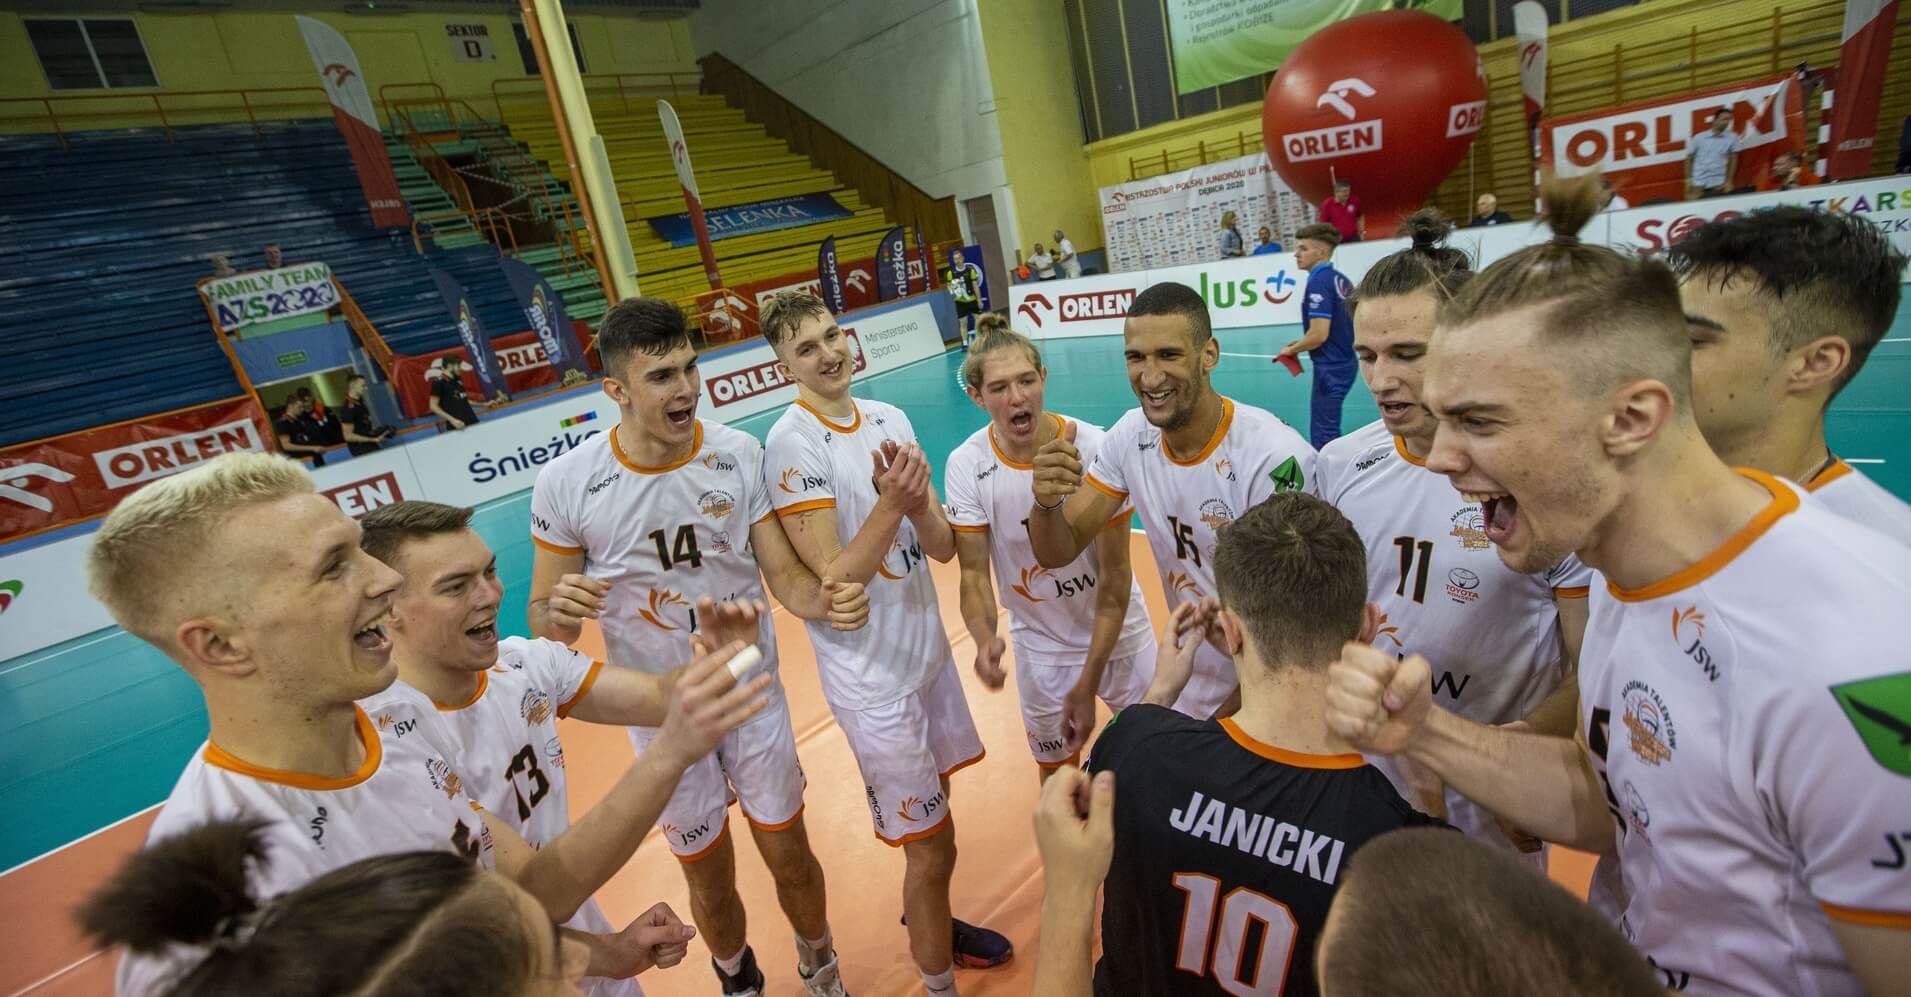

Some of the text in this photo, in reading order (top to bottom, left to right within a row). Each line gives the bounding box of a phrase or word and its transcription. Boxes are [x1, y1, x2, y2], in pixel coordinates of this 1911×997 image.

[463, 40, 482, 58] D
[1290, 125, 1374, 156] ORLEN
[827, 252, 843, 311] nieżka
[892, 240, 907, 297] nieżka
[1062, 293, 1132, 320] ORLEN
[1200, 272, 1259, 309] lus
[865, 321, 918, 344] Ministerstwo
[497, 346, 546, 372] ORLE
[871, 343, 900, 359] Sportu
[713, 362, 790, 401] ORLE
[109, 426, 253, 479] ORLEN
[715, 462, 735, 471] JSW
[1450, 506, 1478, 523] AKADEMIA
[648, 524, 702, 571] 14
[1167, 516, 1202, 568] 15
[1055, 573, 1096, 598] JSW
[1393, 535, 1434, 604] 11
[1445, 584, 1479, 598] TOYOTA
[1683, 638, 1720, 683] JSW
[1621, 679, 1649, 699] AKADEMIA
[1649, 687, 1677, 750] TALENTÓW
[1038, 737, 1064, 753] JSW
[505, 744, 550, 823] 13
[922, 791, 944, 818] JSW
[681, 819, 710, 847] JSW
[1168, 791, 1345, 886] JANICKI
[1170, 871, 1301, 997] 10
